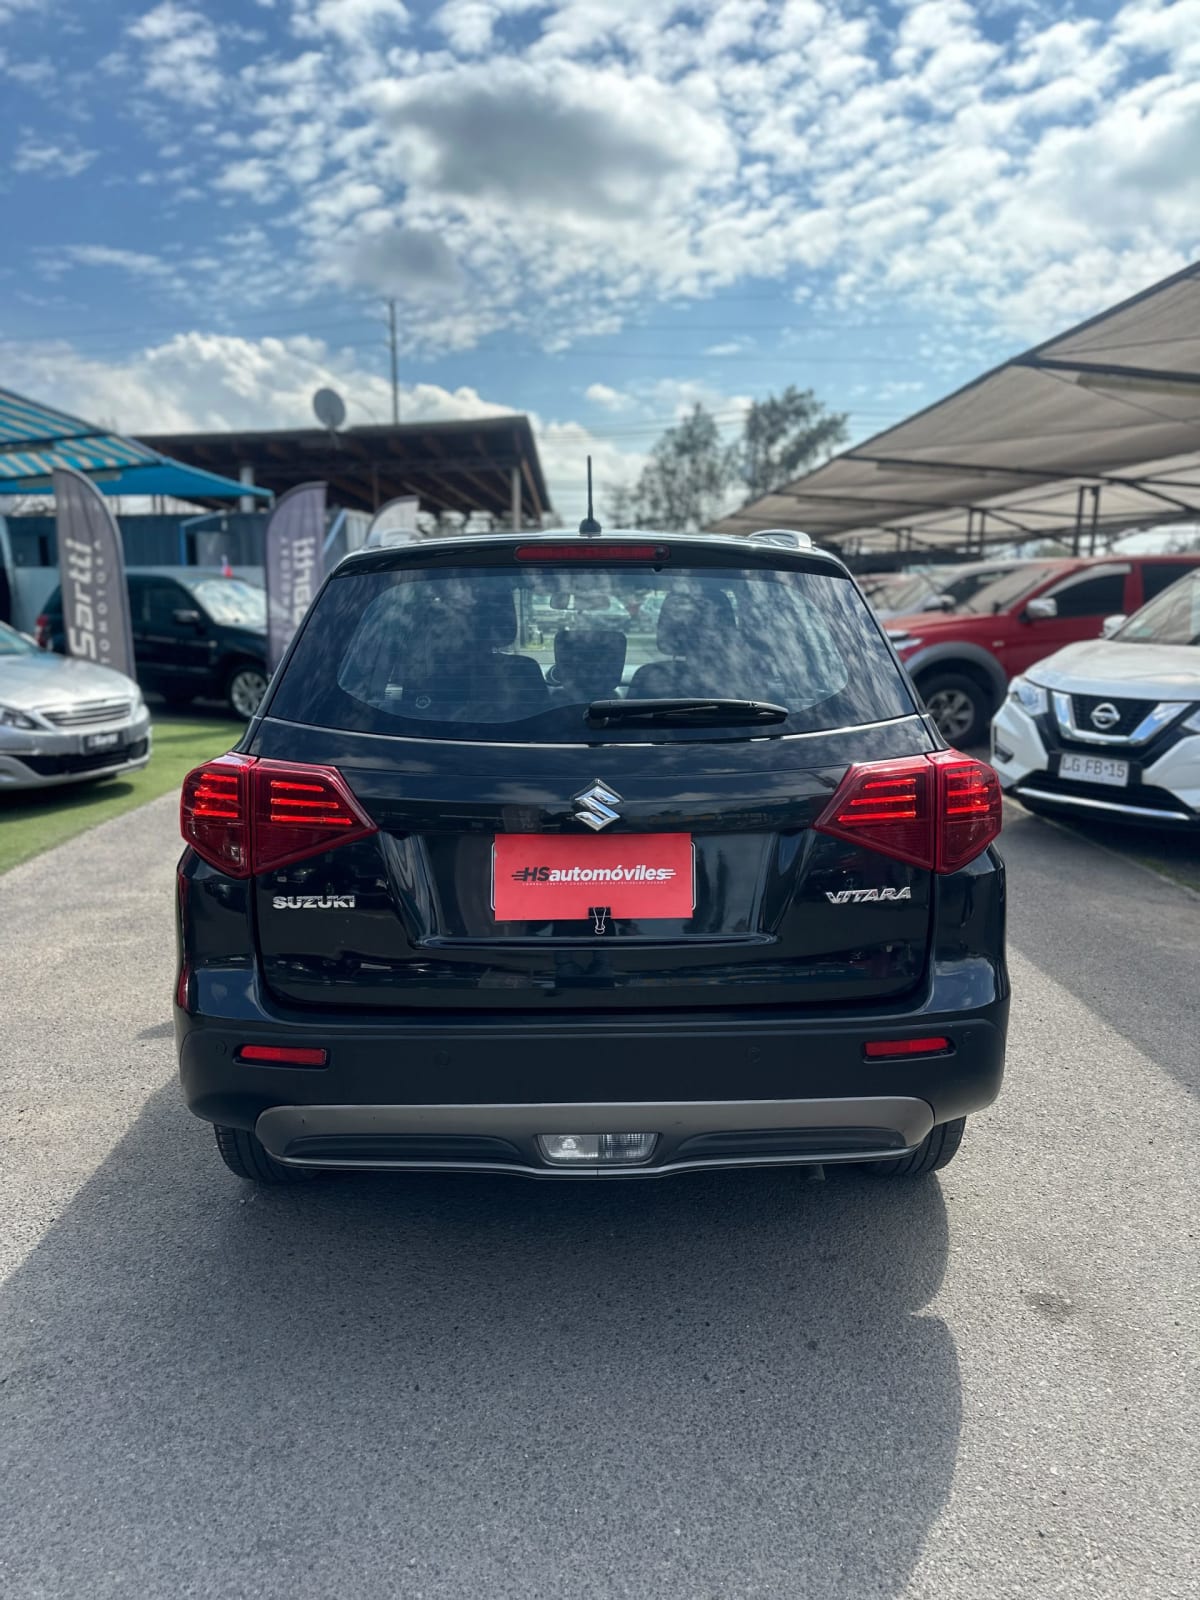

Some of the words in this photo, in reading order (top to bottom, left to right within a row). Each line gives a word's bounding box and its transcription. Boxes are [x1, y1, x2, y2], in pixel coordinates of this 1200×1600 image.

[66, 537, 97, 660] Sartti
[521, 864, 667, 882] HSautomóviles
[272, 895, 356, 909] SUZUKI
[825, 886, 912, 904] VITARA
